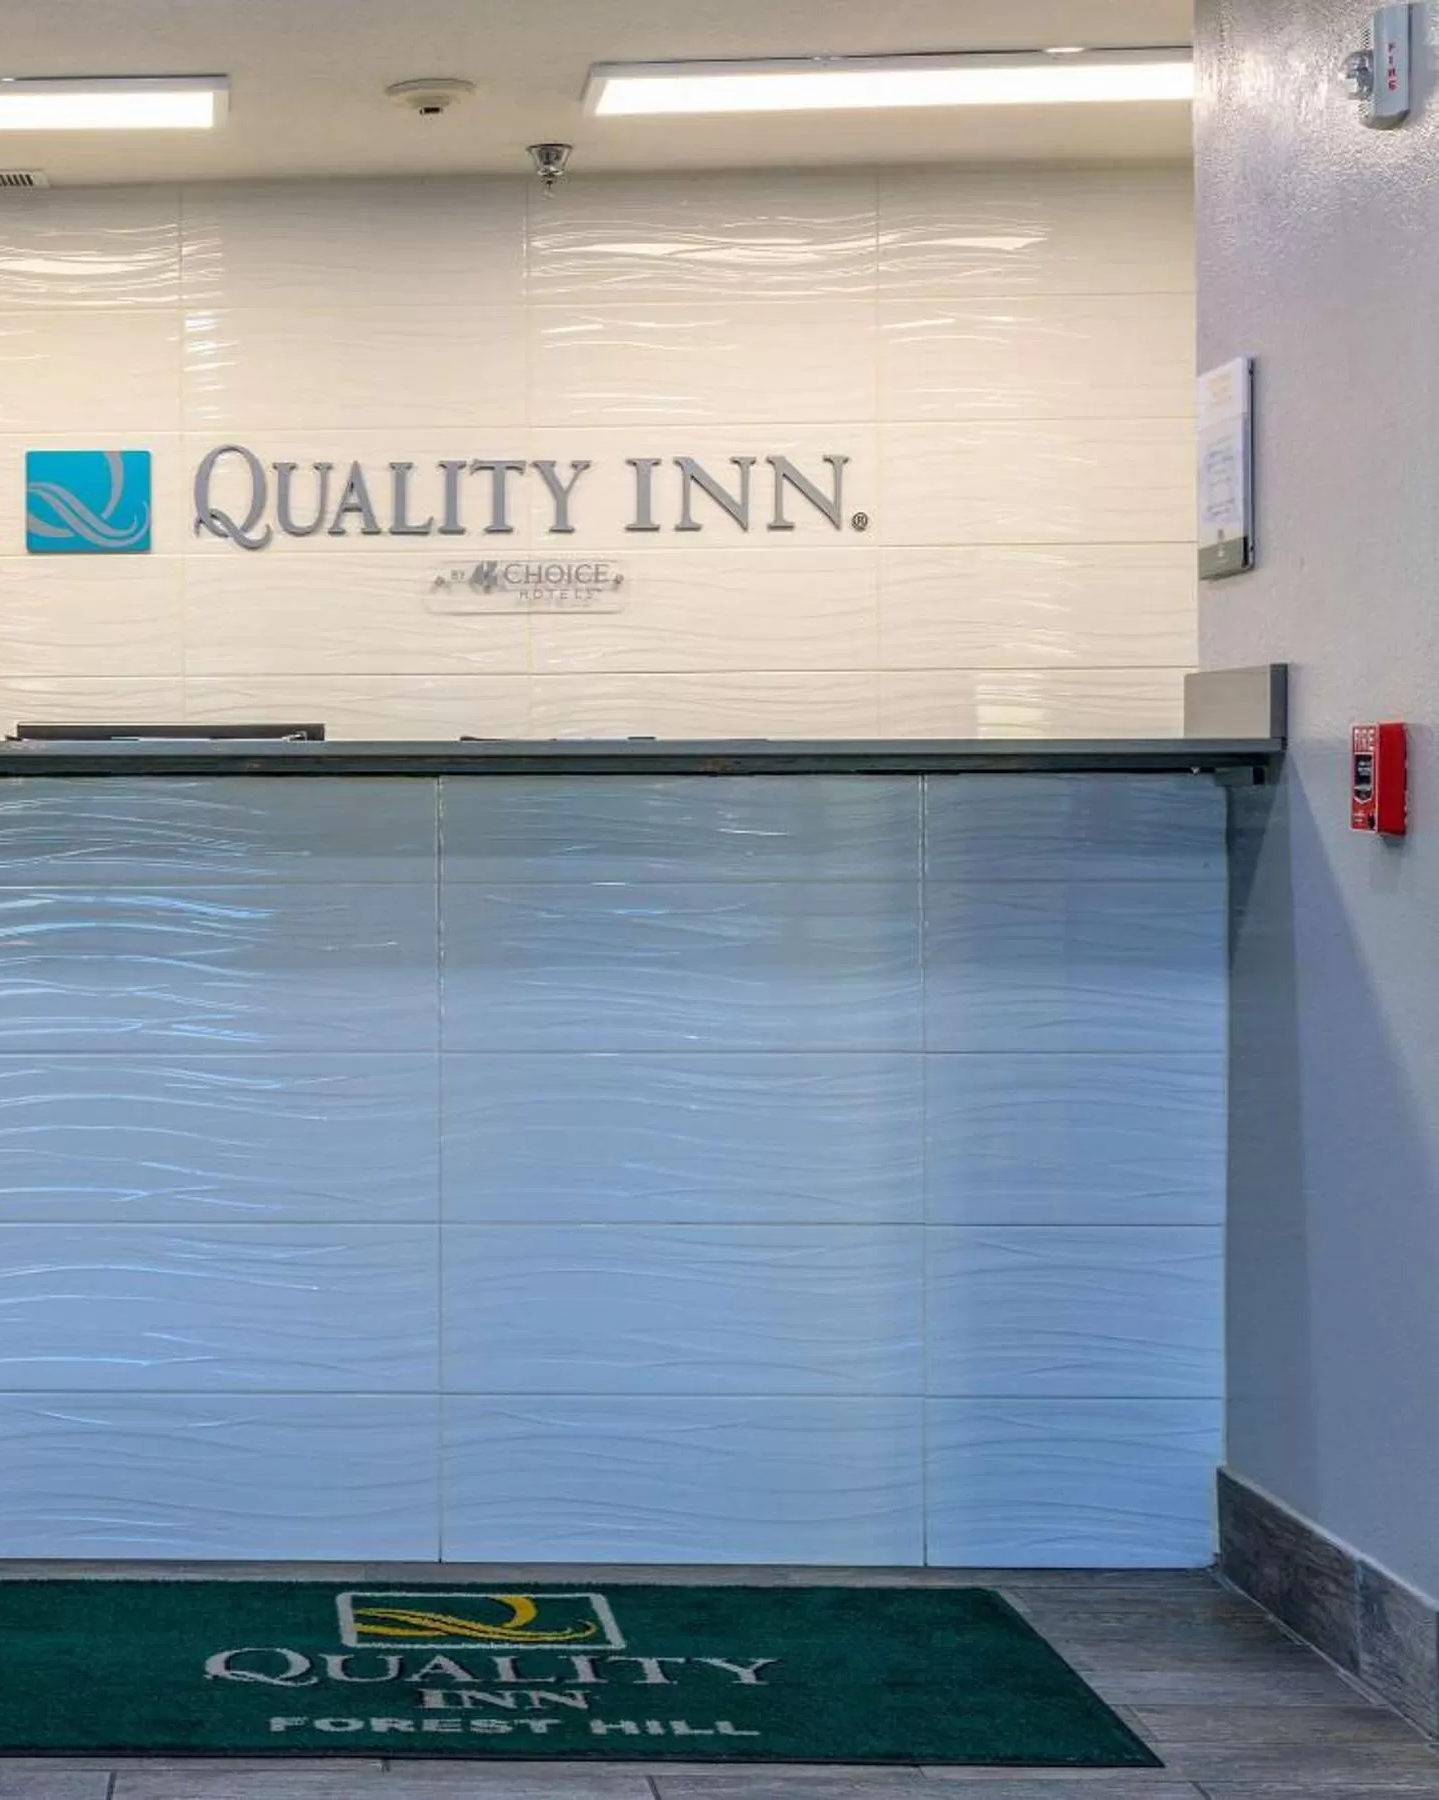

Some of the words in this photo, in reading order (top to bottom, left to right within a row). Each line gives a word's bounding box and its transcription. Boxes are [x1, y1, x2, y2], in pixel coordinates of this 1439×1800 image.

[194, 444, 591, 551] QUALITY
[503, 563, 610, 586] CHOICE
[518, 588, 596, 601] HOTELS
[202, 1646, 778, 1687] QUALITY
[415, 1688, 594, 1710] INN
[268, 1715, 562, 1735] FOREST
[588, 1718, 761, 1737] HILL
